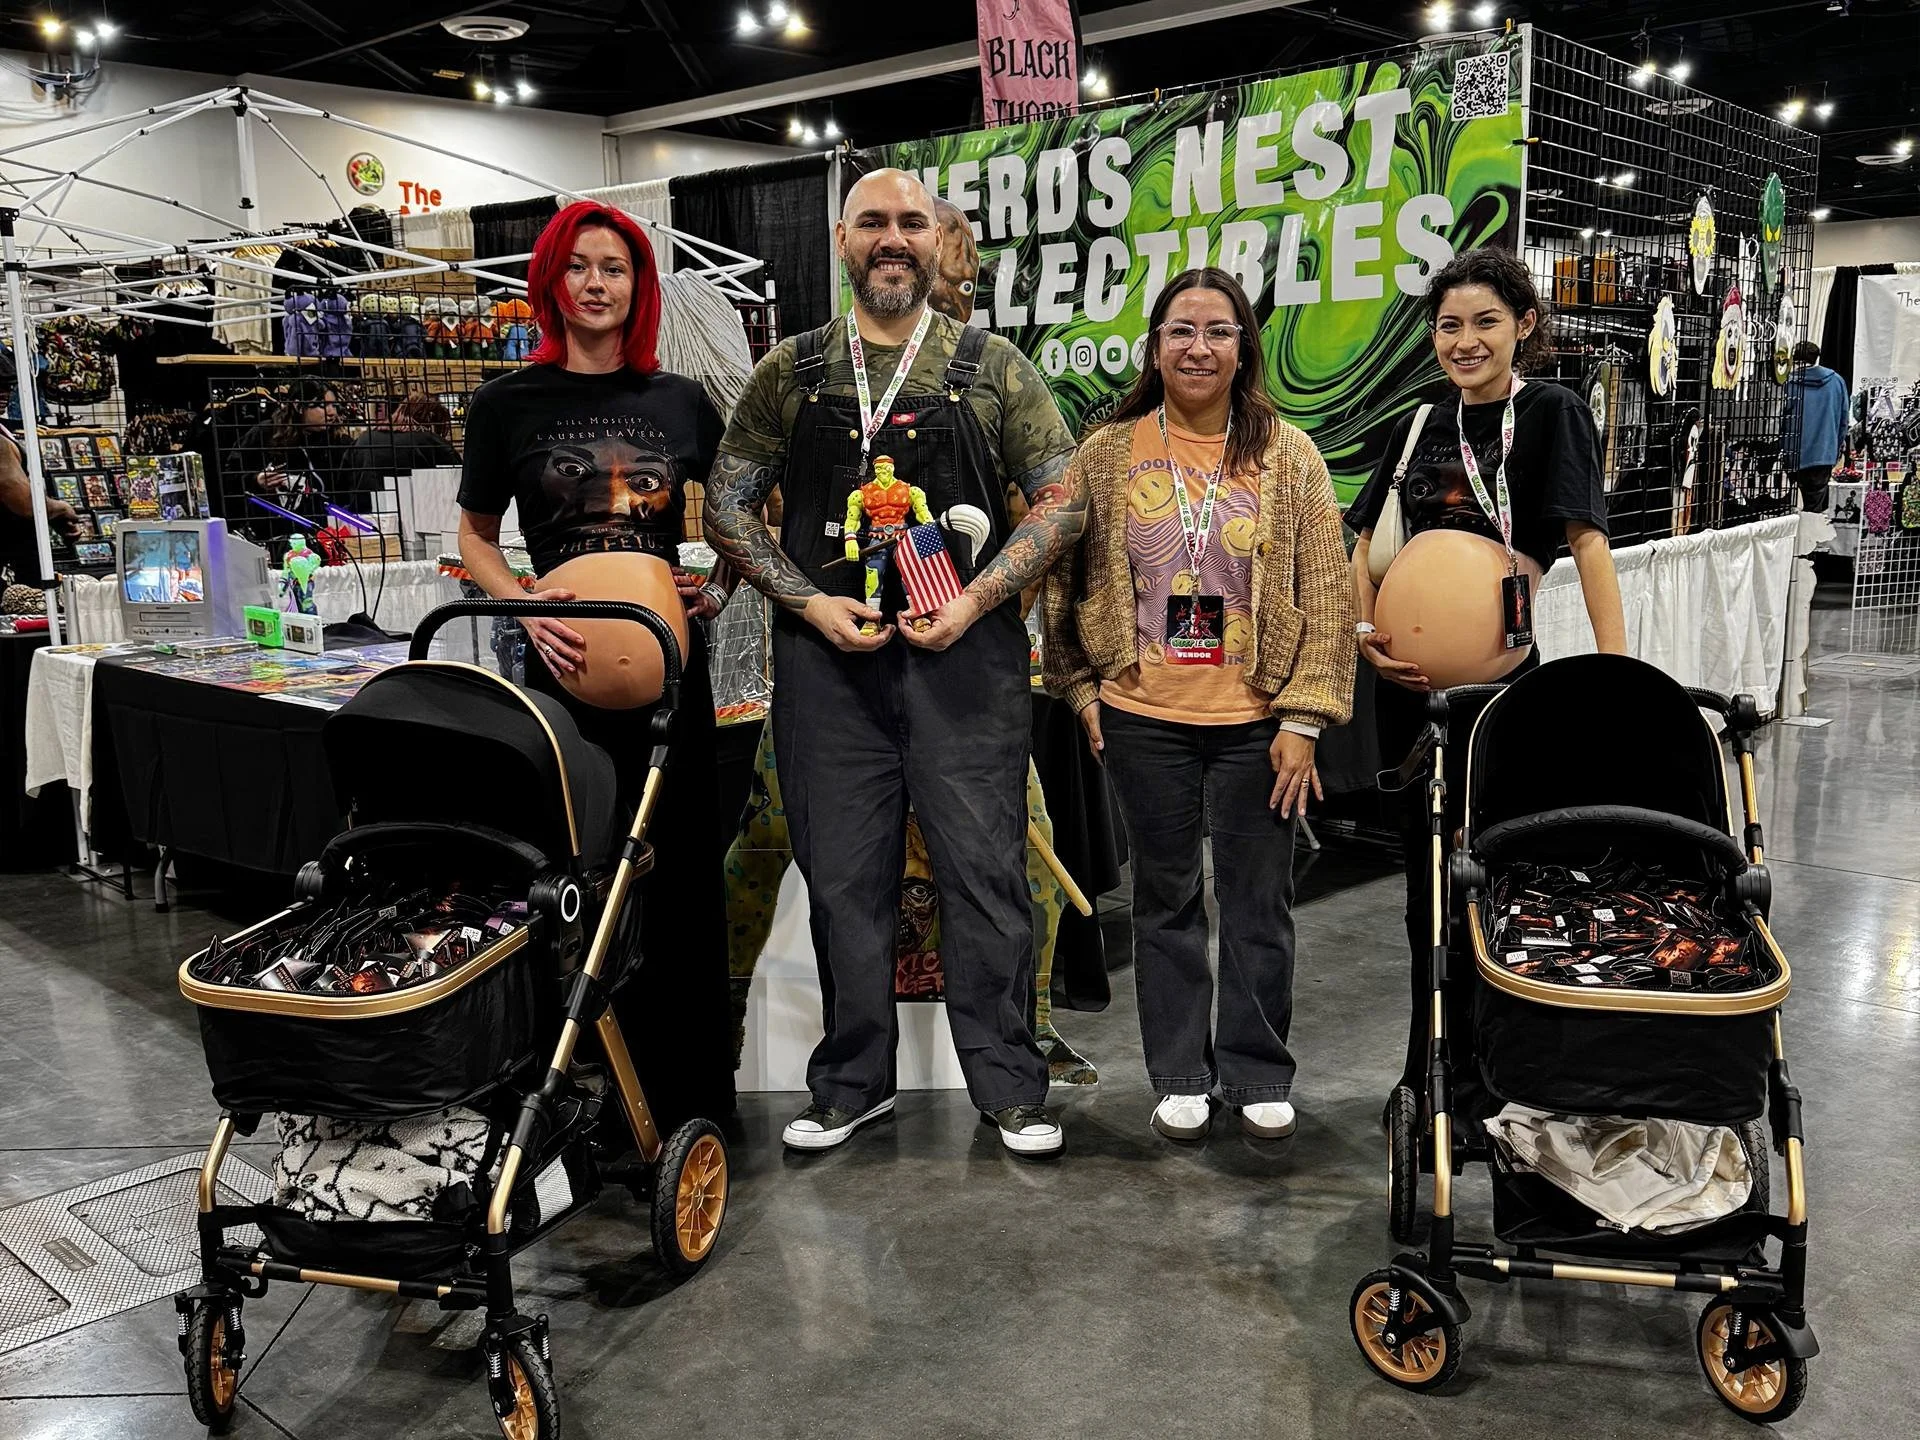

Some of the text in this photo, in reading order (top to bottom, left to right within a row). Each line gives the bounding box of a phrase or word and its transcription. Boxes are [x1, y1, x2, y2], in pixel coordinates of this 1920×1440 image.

[986, 36, 1072, 80] BLACK
[1172, 88, 1412, 218] NEST
[398, 181, 442, 207] The
[969, 194, 1455, 328] LECTIBLES
[537, 431, 596, 441] LAUREN
[1176, 651, 1212, 659] VENDOR
